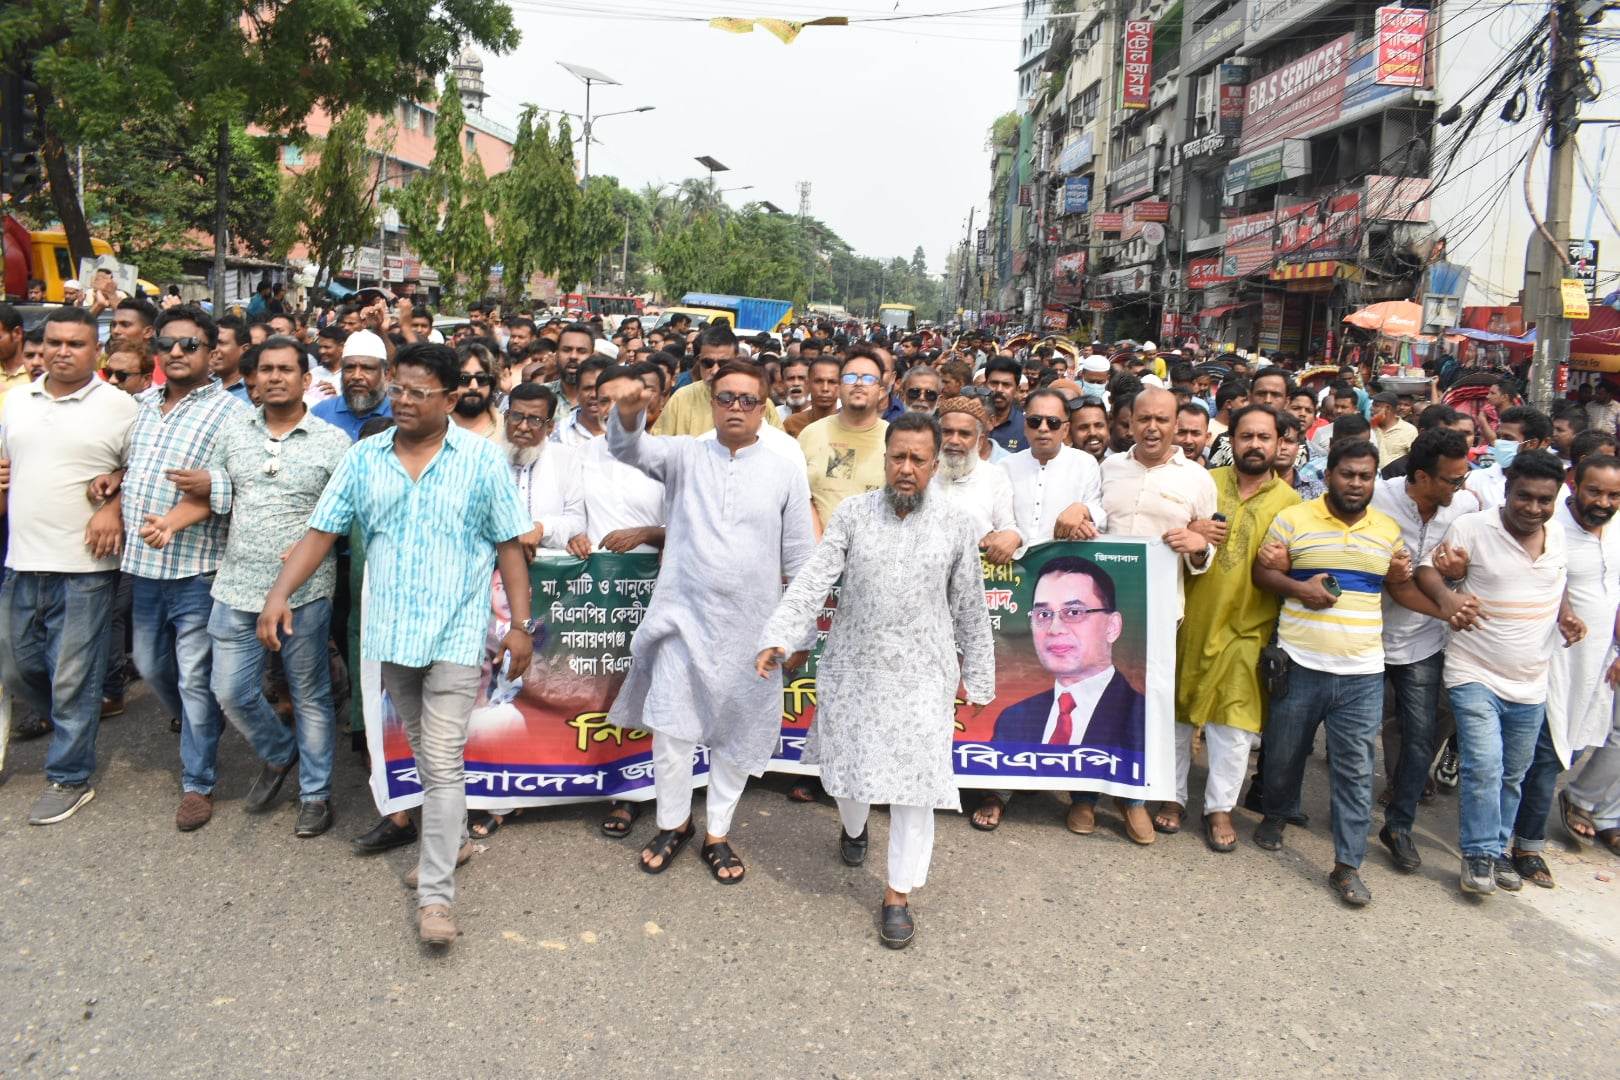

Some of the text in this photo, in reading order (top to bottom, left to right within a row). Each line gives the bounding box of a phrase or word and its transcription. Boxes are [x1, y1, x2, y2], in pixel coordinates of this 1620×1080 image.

[1128, 22, 1151, 62] হোটেল
[1279, 41, 1344, 100] SERVICES
[541, 580, 561, 598] মা,
[566, 573, 593, 595] মাটি
[598, 580, 609, 595] ও
[550, 601, 648, 625] বিএনপির কেন্দ্রী
[561, 630, 626, 650] নারায়ণগঞ্জ
[569, 654, 633, 676] থানা বিএন
